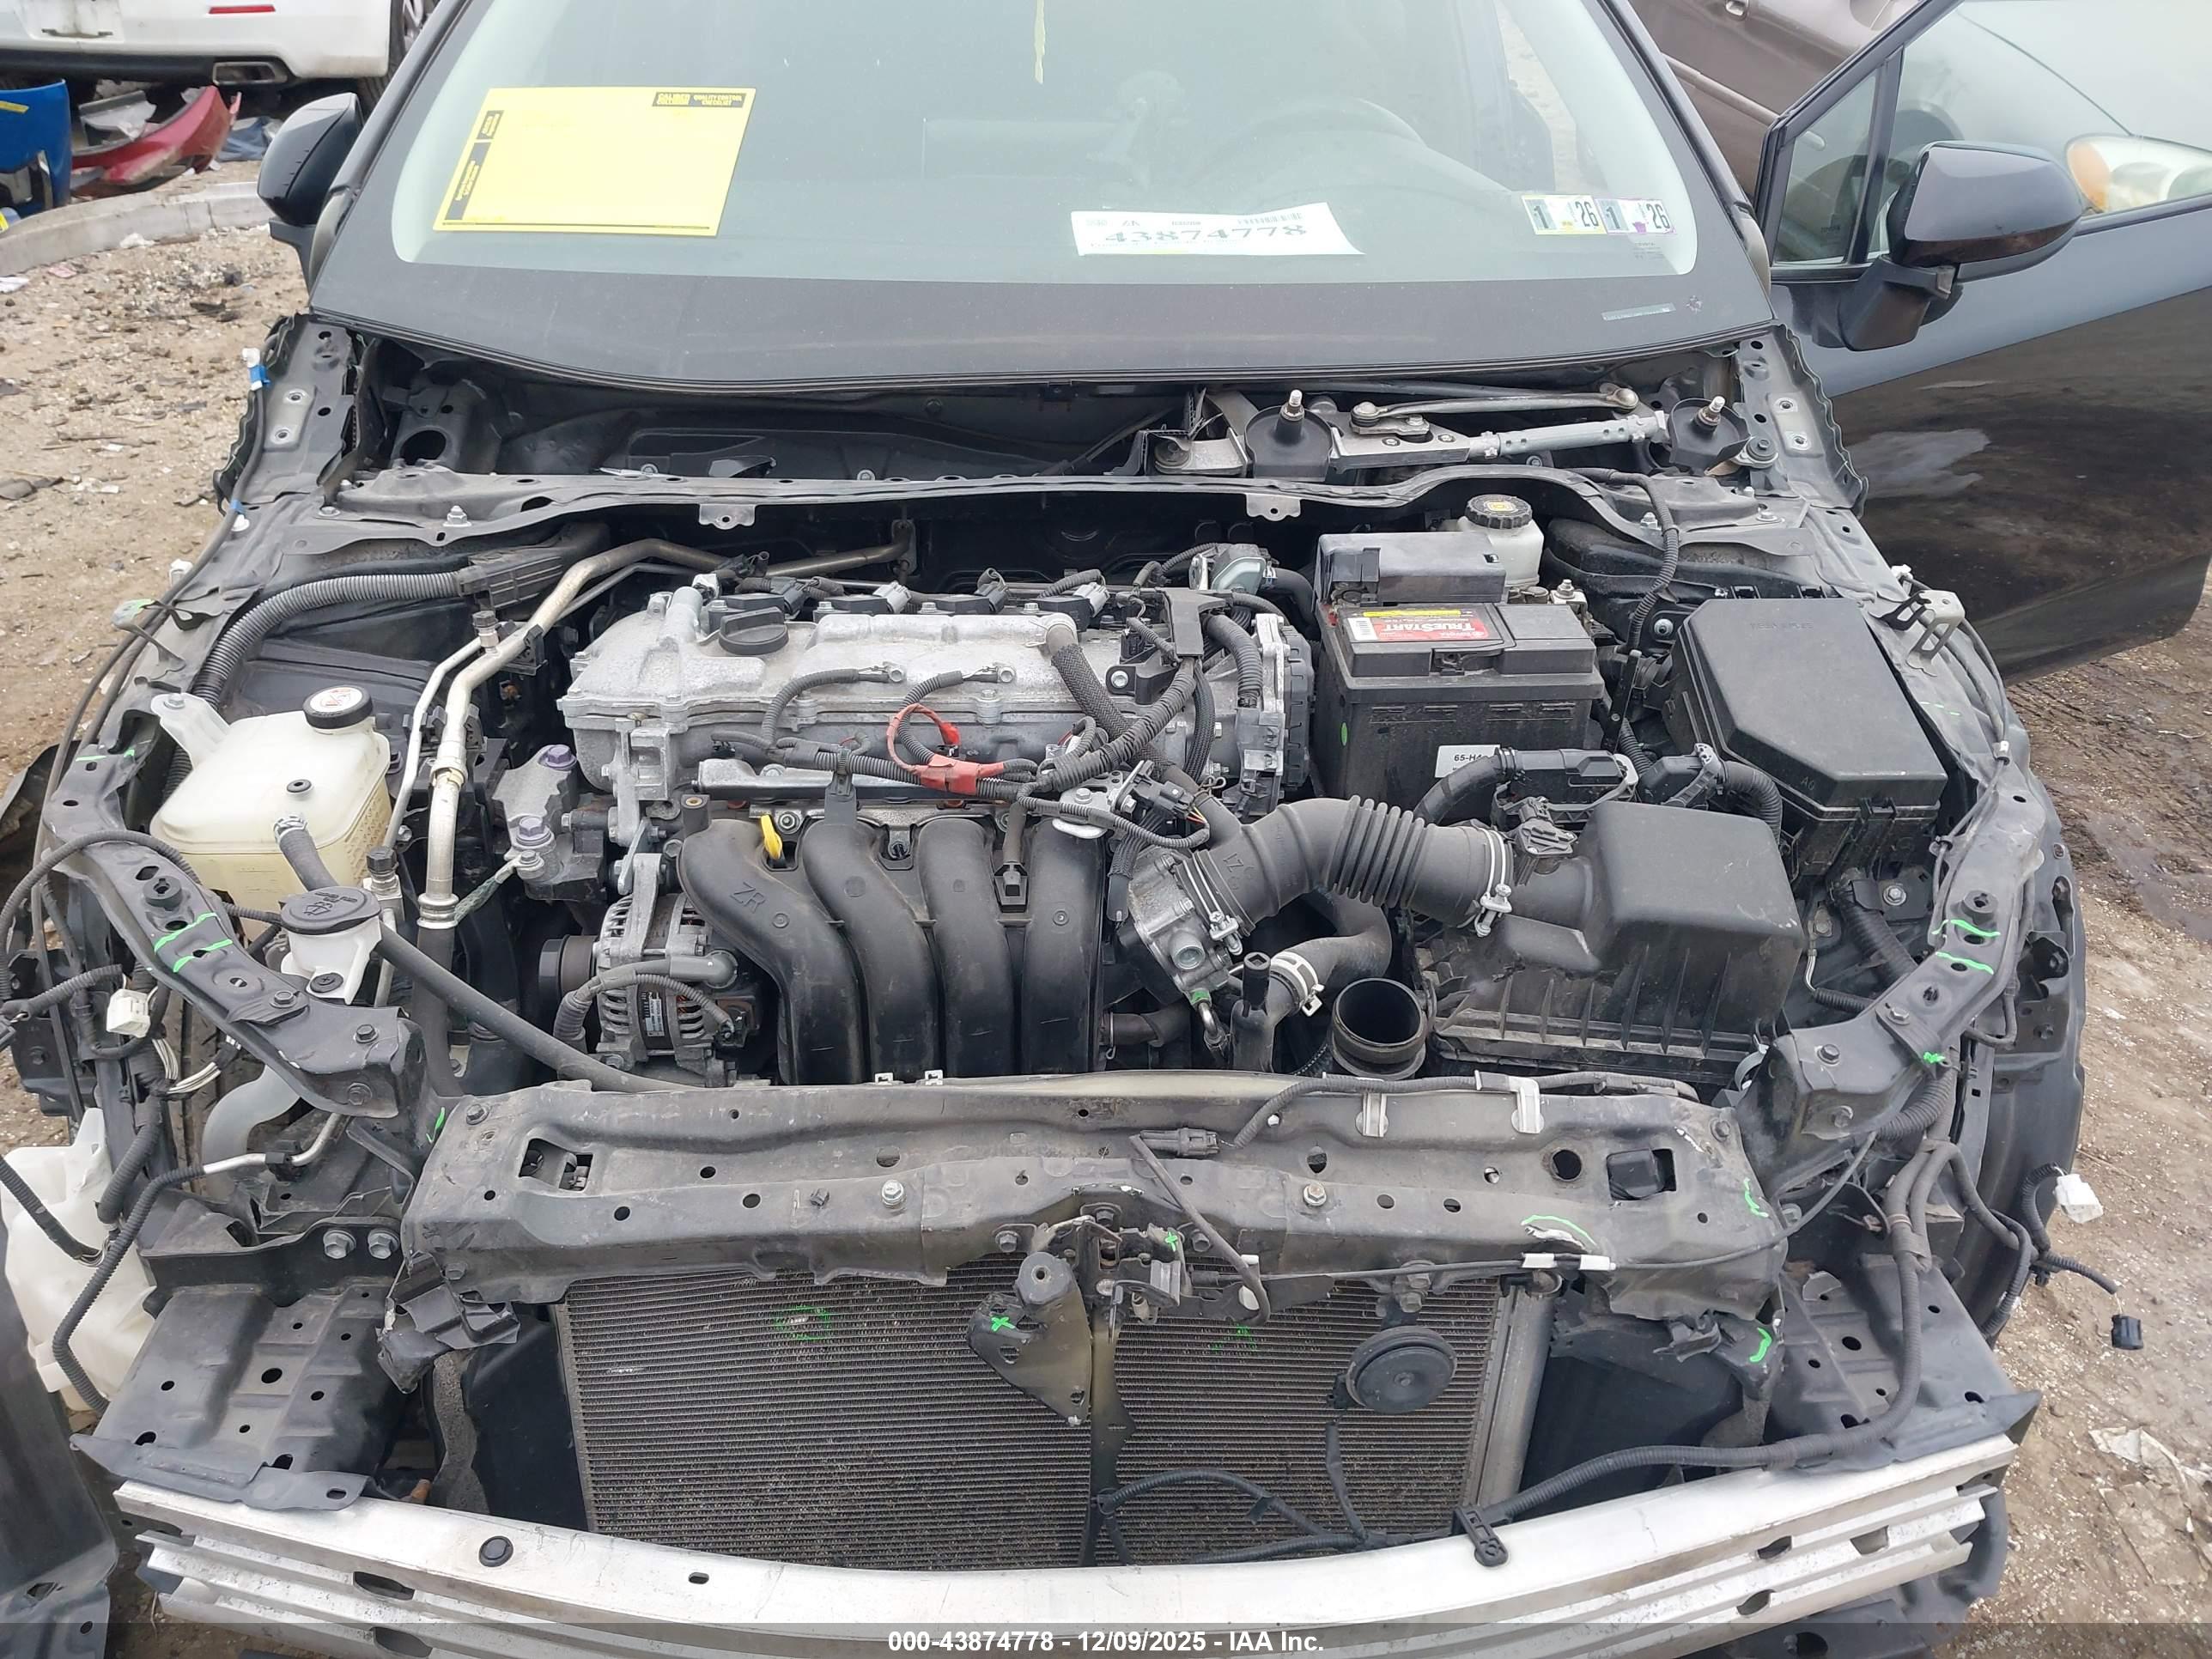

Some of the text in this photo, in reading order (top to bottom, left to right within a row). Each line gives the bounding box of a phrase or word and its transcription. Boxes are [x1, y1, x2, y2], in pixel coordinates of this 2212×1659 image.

[1534, 205, 1549, 229] 1
[1575, 201, 1599, 228] 26
[1606, 206, 1621, 229] 1
[1646, 203, 1671, 229] 26
[1105, 225, 1307, 242] 43874778
[729, 881, 767, 915] ZR
